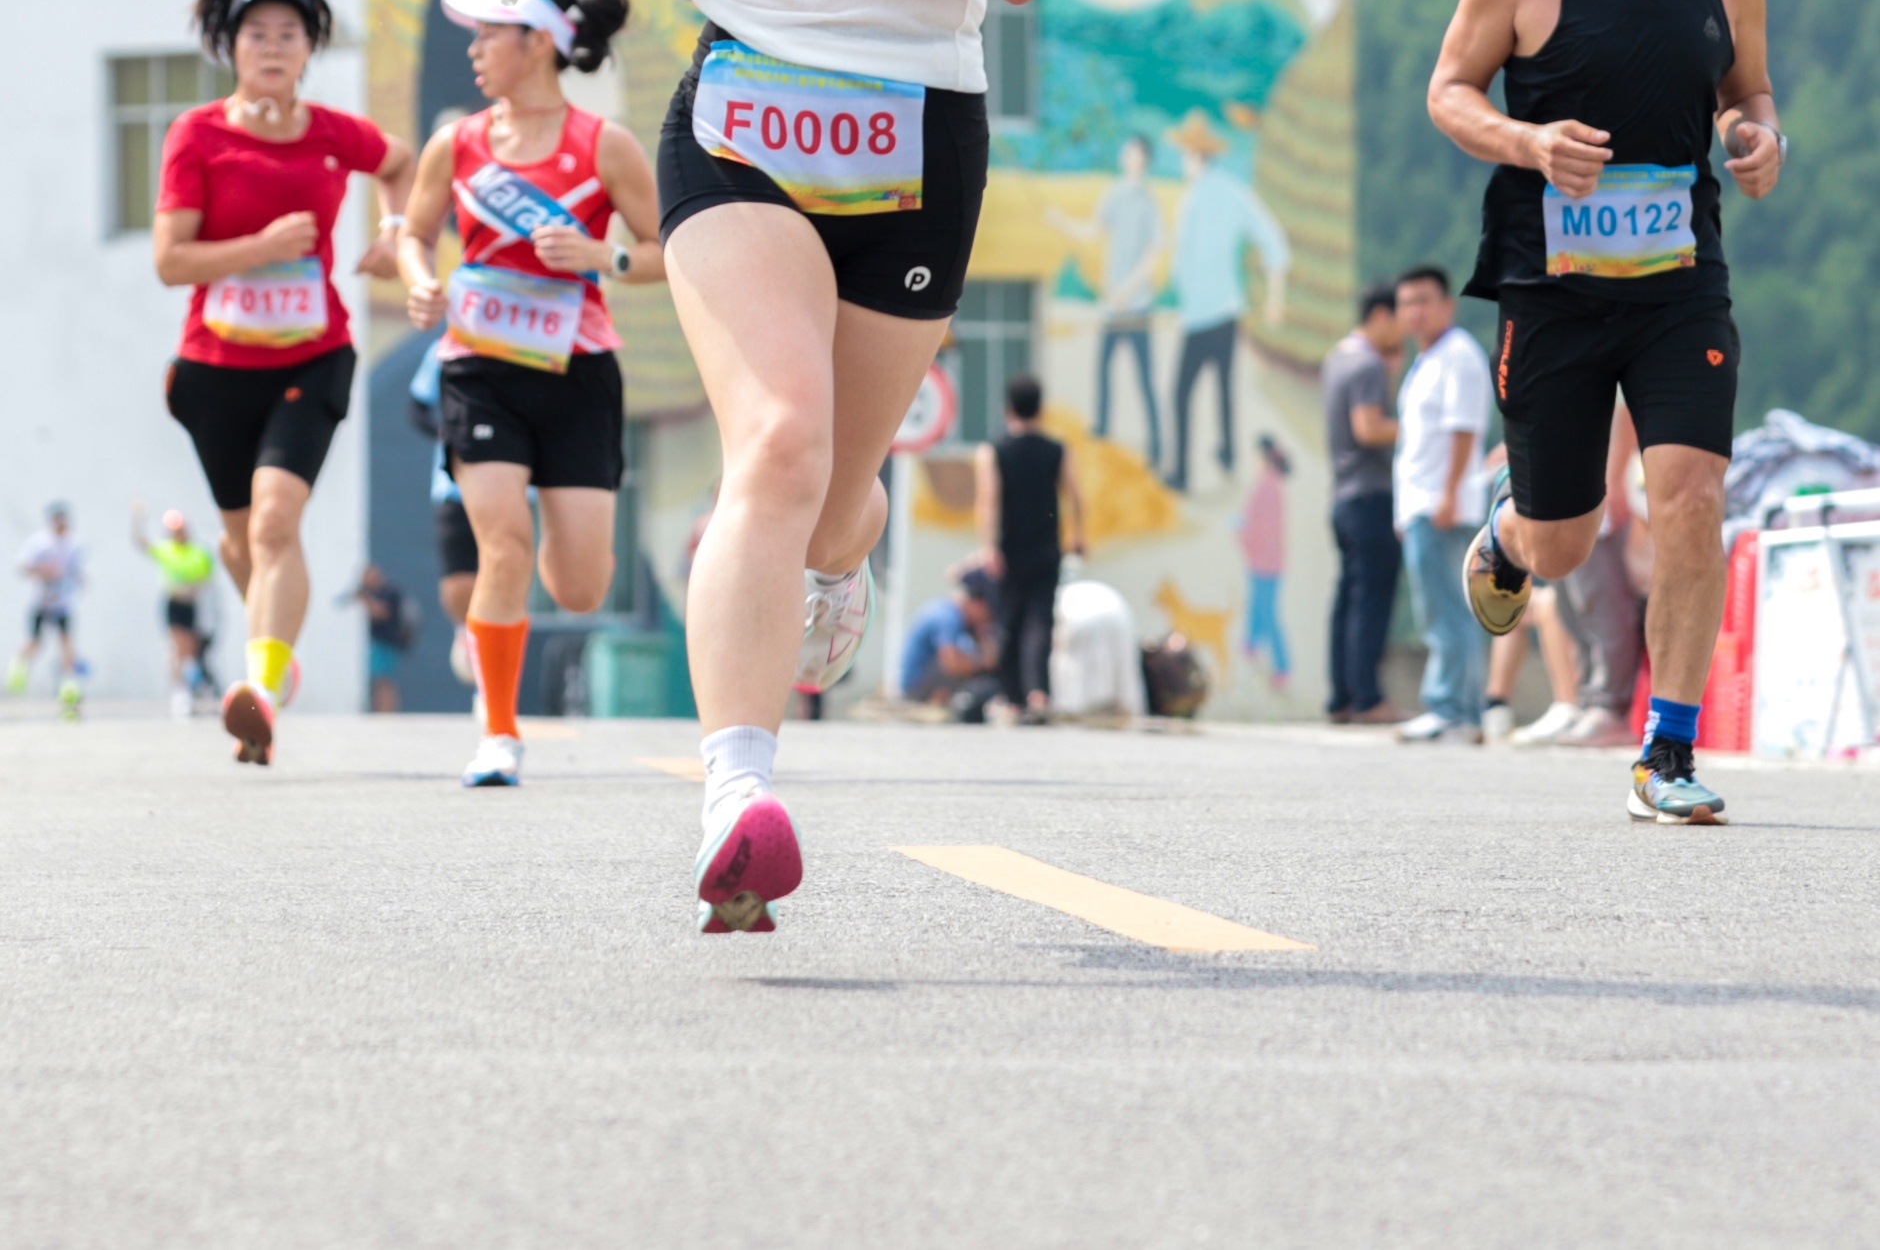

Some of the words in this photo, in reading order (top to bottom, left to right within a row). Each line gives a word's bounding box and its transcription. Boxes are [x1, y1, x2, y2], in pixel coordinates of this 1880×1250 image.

[723, 100, 897, 156] F0008
[467, 160, 583, 234] Marat
[1561, 200, 1683, 237] M0122
[221, 286, 311, 315] F0172
[461, 290, 562, 336] F0116
